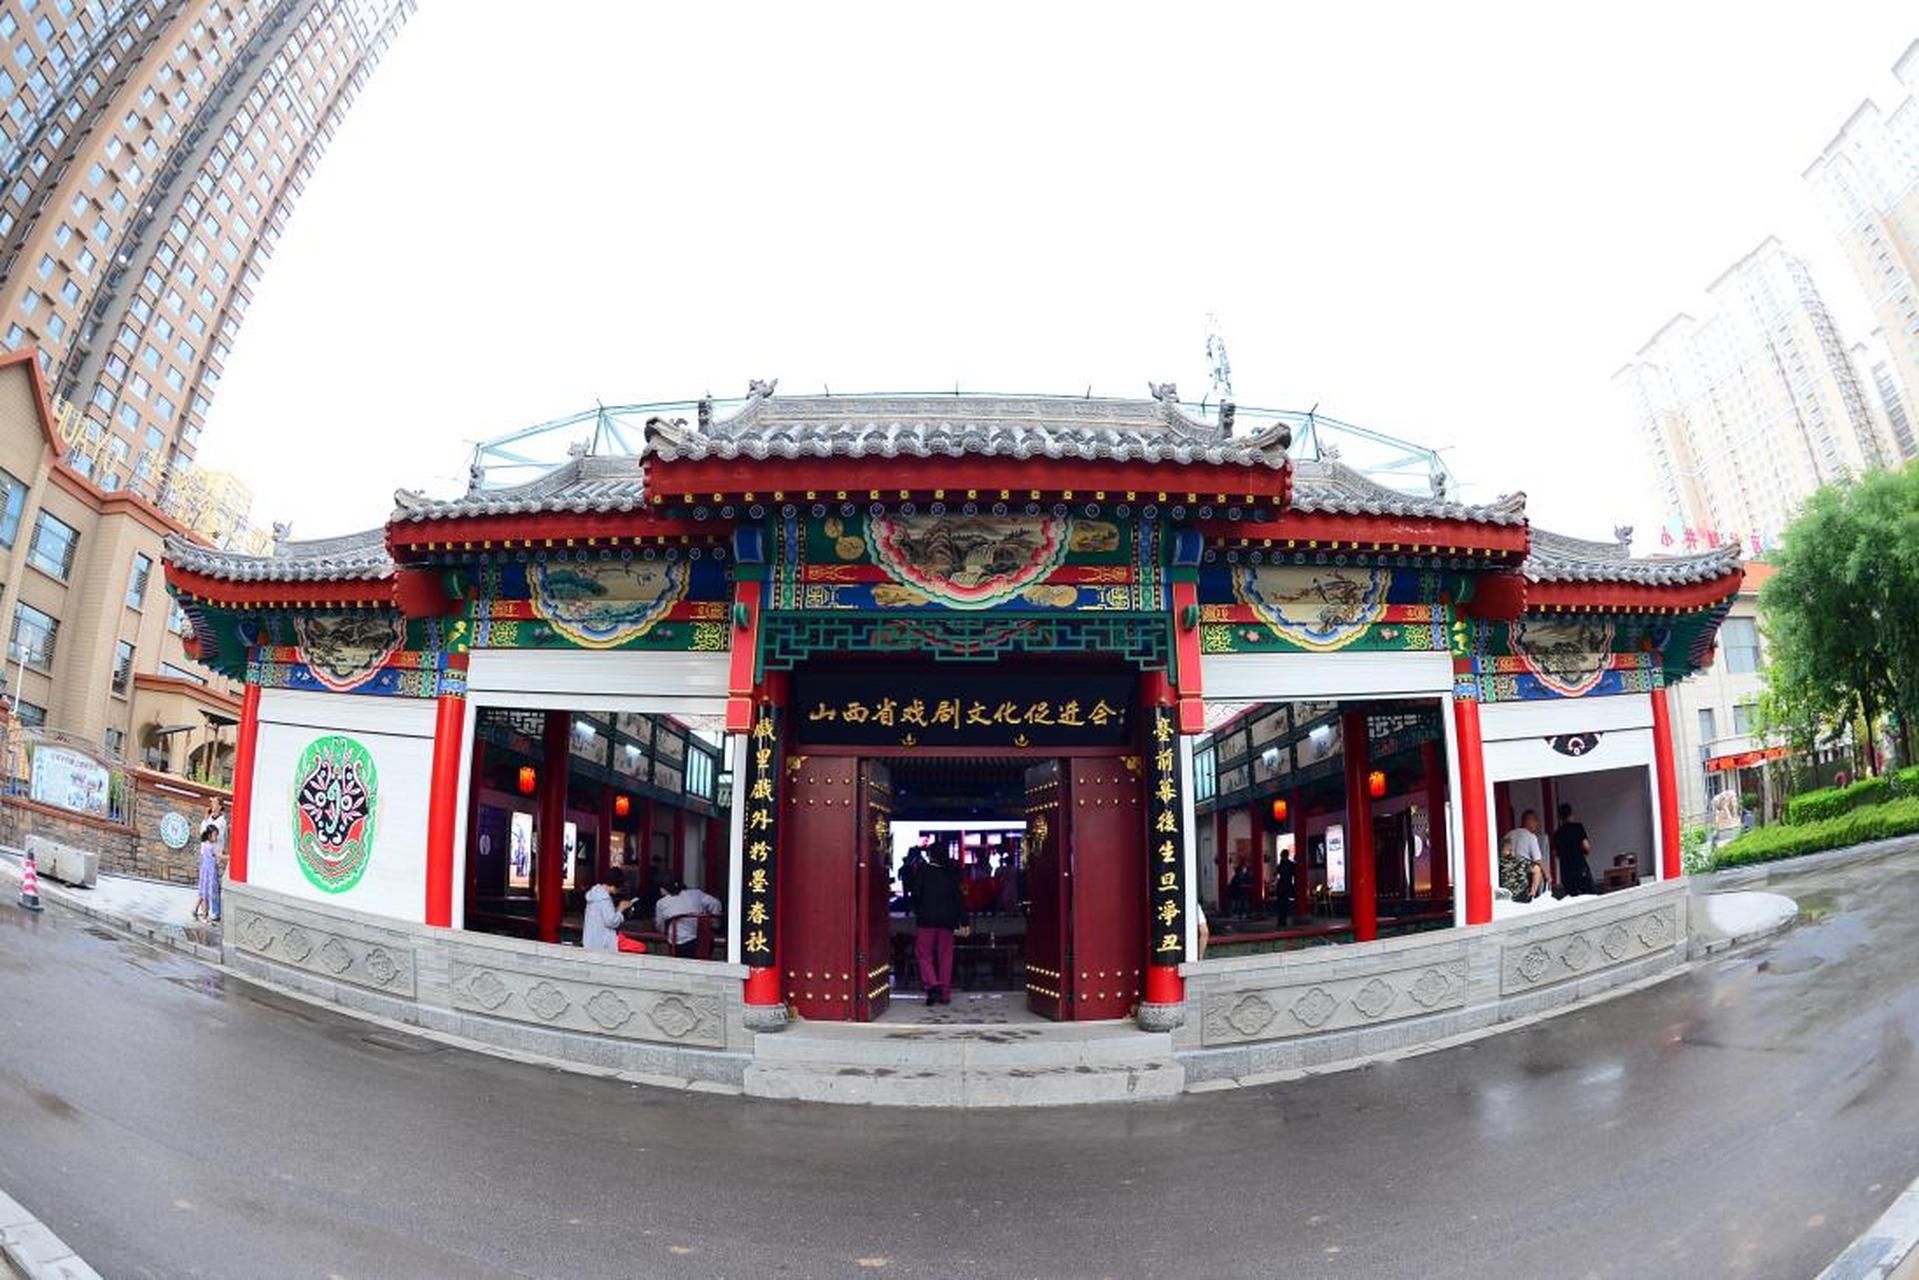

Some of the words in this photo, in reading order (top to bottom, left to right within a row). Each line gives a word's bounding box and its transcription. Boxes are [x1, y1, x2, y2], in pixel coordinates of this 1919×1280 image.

[809, 698, 1117, 730] 山西省戏剧文化促进会
